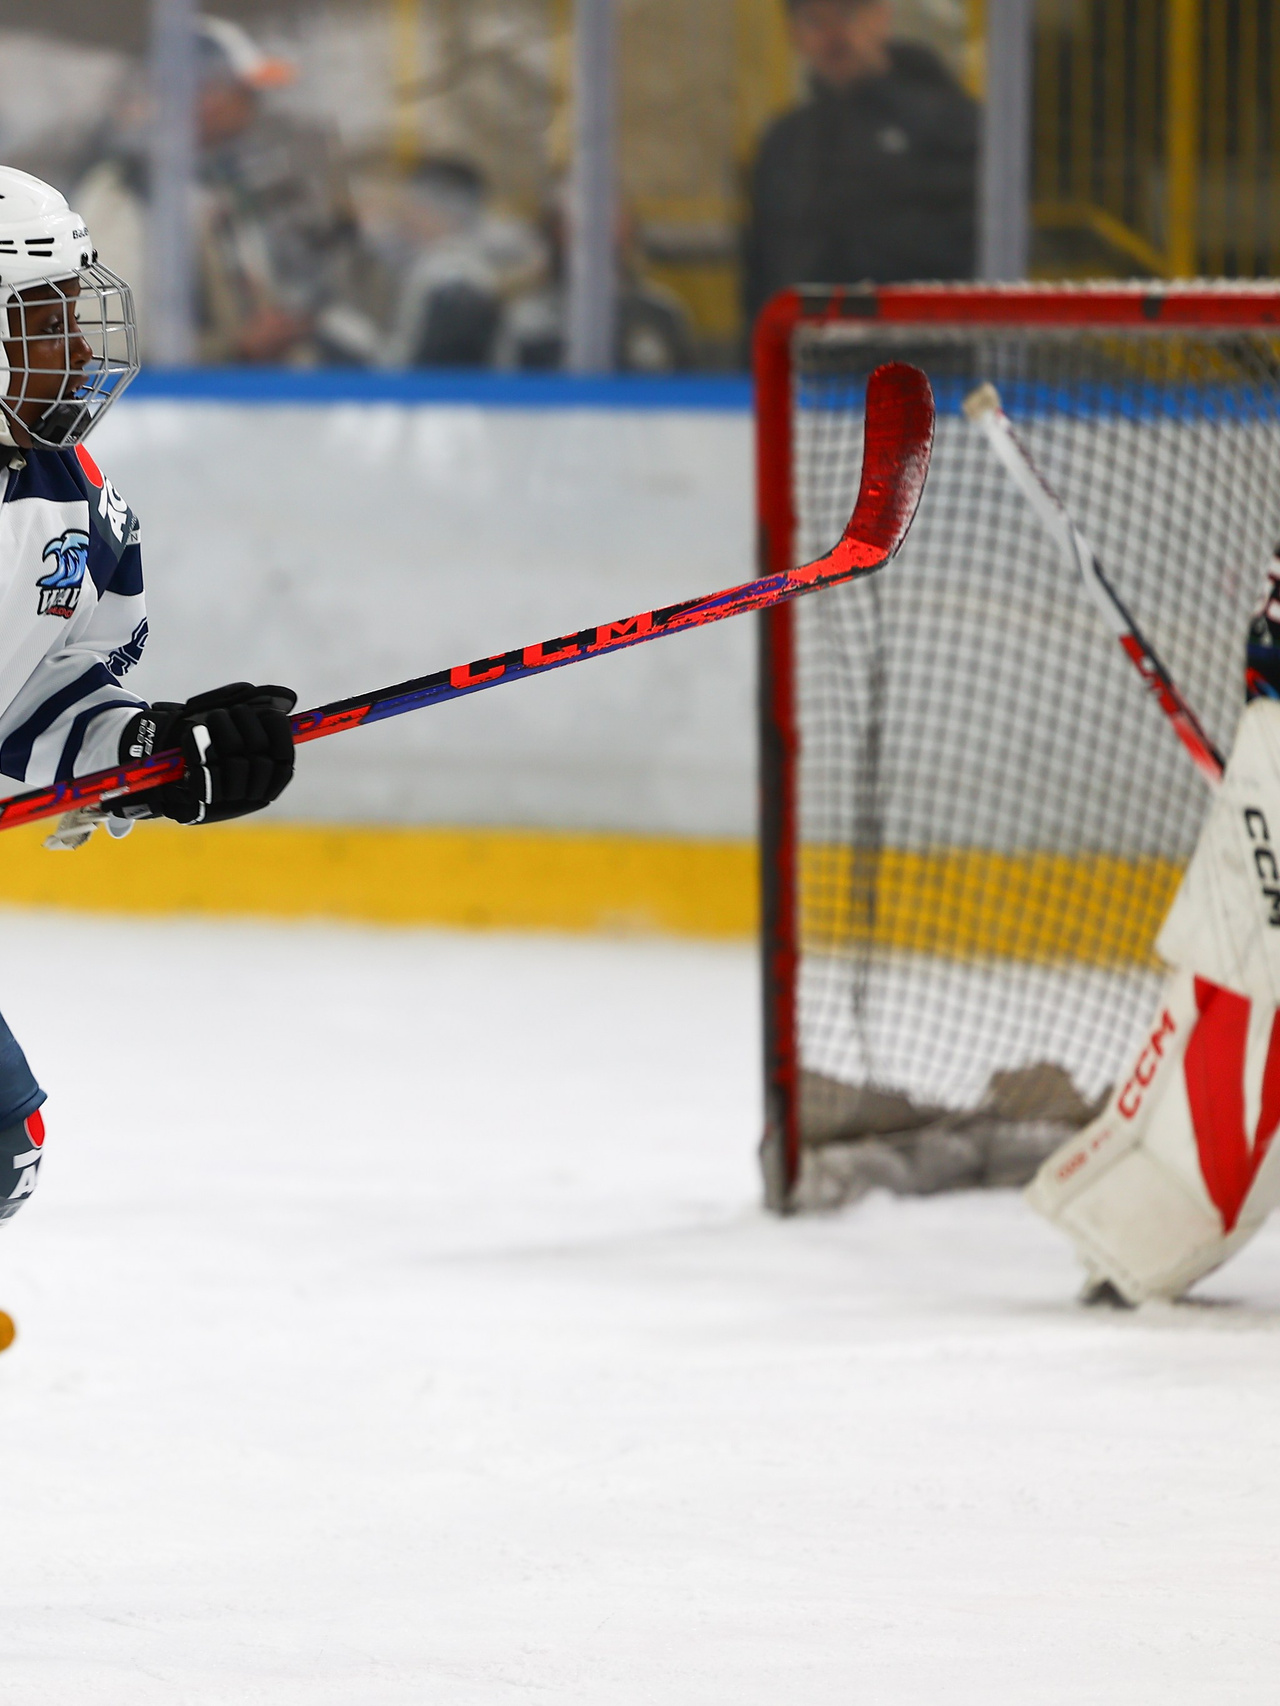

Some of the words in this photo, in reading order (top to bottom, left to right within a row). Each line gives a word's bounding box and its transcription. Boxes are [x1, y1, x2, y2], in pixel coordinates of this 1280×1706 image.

[450, 609, 652, 689] CCM
[1243, 807, 1280, 926] CCM
[1117, 1008, 1176, 1121] CCM
